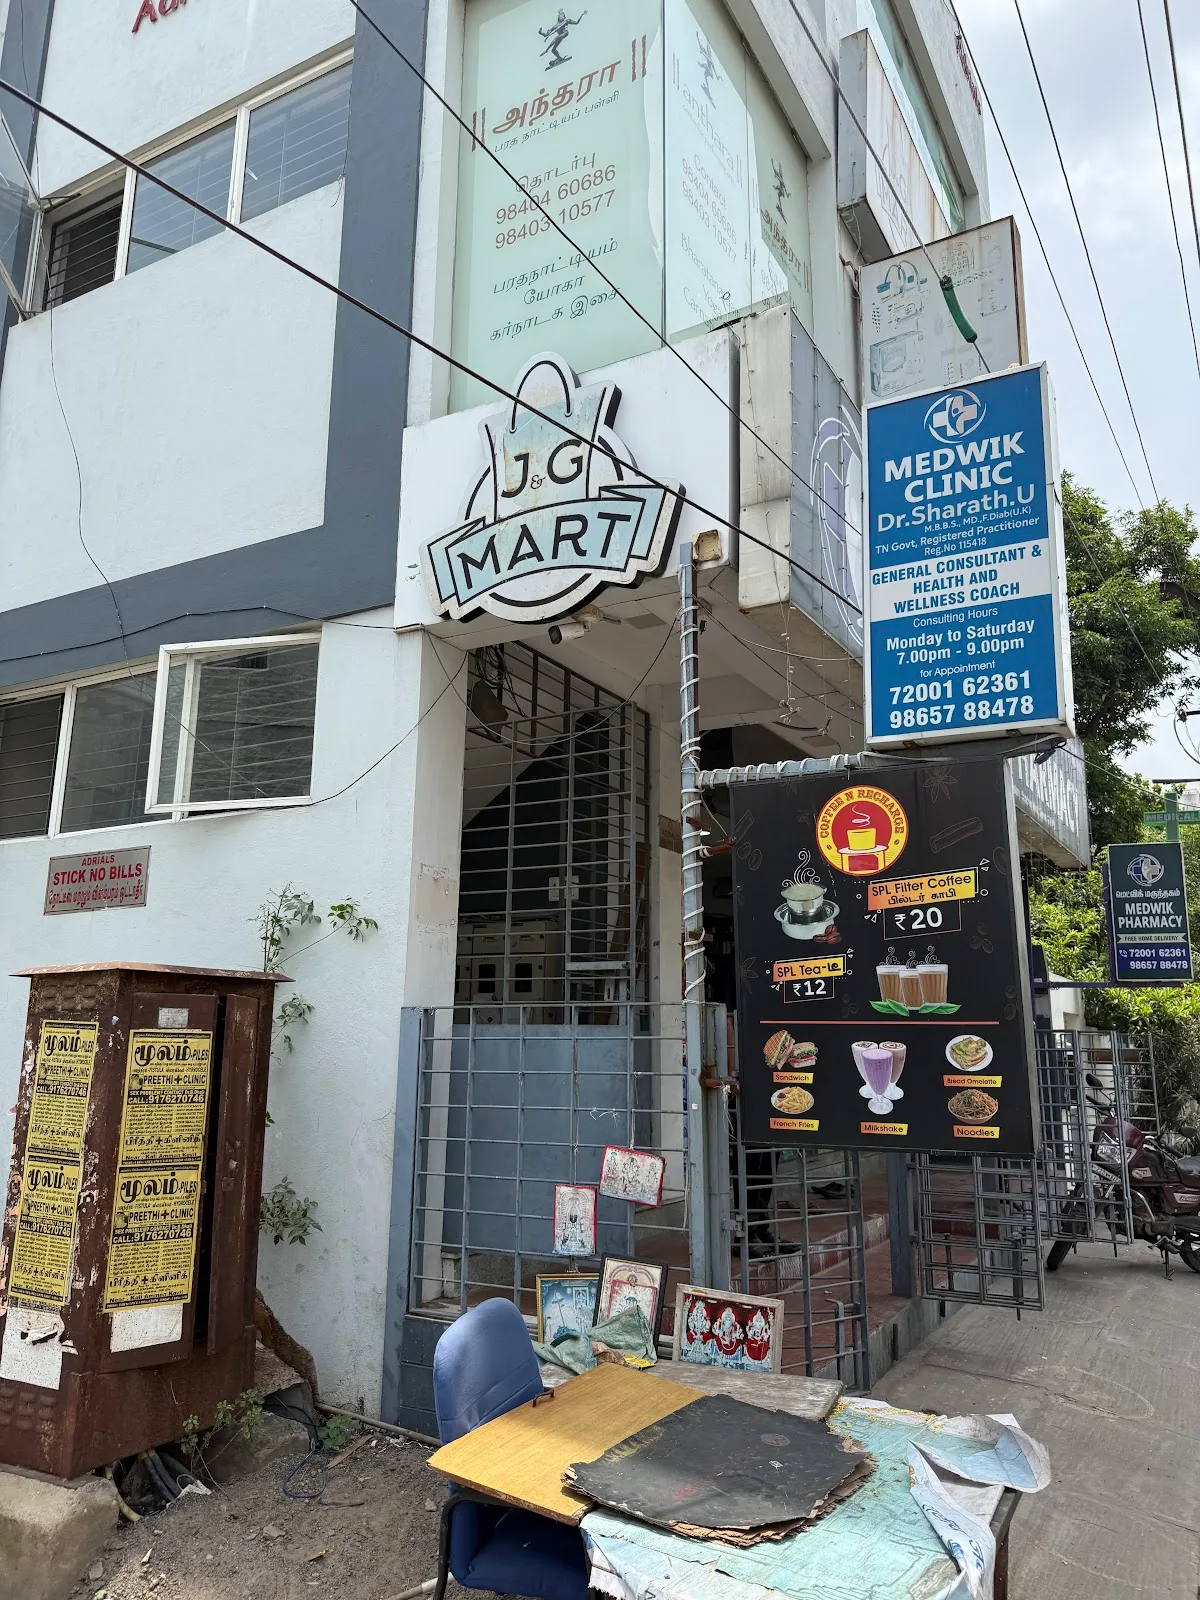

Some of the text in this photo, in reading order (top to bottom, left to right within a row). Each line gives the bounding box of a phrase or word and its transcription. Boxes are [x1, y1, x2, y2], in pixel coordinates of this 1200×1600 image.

[492, 60, 622, 135] அந்தரா
[494, 91, 619, 153] பரத நாட்டியப் பள்ளி
[516, 153, 596, 193] தொடர்பு
[694, 154, 727, 211] Contact
[496, 165, 616, 225] 98404 60686
[496, 189, 616, 249] 98403 10577
[493, 237, 618, 294] பரதநாட்டியம்
[524, 275, 586, 305] யோகா
[490, 287, 621, 340] கர்நாடக இசை
[884, 431, 1025, 482] MEDWIK
[904, 461, 1013, 503] CLINIC
[877, 483, 1035, 533] Dr.Sharath.U
[875, 516, 1040, 554] TN Govt, Registered Practitioner
[924, 537, 987, 557] Reg.No 115418
[457, 511, 632, 590] MART
[872, 544, 1042, 586] GENERAL CONSULTANT &
[913, 569, 998, 594] HEALTH AND
[894, 582, 1020, 613] WELLNESS COACH
[913, 607, 998, 628] Consulting Hours
[887, 619, 1035, 651] Monday to Saturday
[897, 647, 951, 665] 7.00pm
[967, 637, 1025, 656] 9.00pm
[920, 660, 996, 678] for Appointment
[889, 670, 1030, 705] 72001 62361
[890, 695, 1034, 729] 98657 88478
[820, 789, 905, 838] COFFEE N RECHARGE
[53, 863, 142, 886] STICK NO BILLS
[81, 854, 115, 867] ADRIALS
[872, 875, 972, 897] SPL Filter Coffee
[931, 888, 957, 900] காபி
[1118, 915, 1183, 929] PHARMACY
[1125, 902, 1174, 915] MEDWIK
[1128, 948, 1186, 958] 72001 62361
[1130, 960, 1188, 970] 98657 88478
[777, 966, 796, 978] SPL
[143, 1074, 206, 1085] PREETHI CLINIC
[775, 1073, 810, 1083] Sandwich
[967, 1077, 997, 1086] Omelette
[773, 1120, 815, 1129] French Fries
[864, 1124, 904, 1134] Milkshake
[957, 1127, 995, 1137] Noodles
[129, 1208, 194, 1222] PREETHI CLINIC
